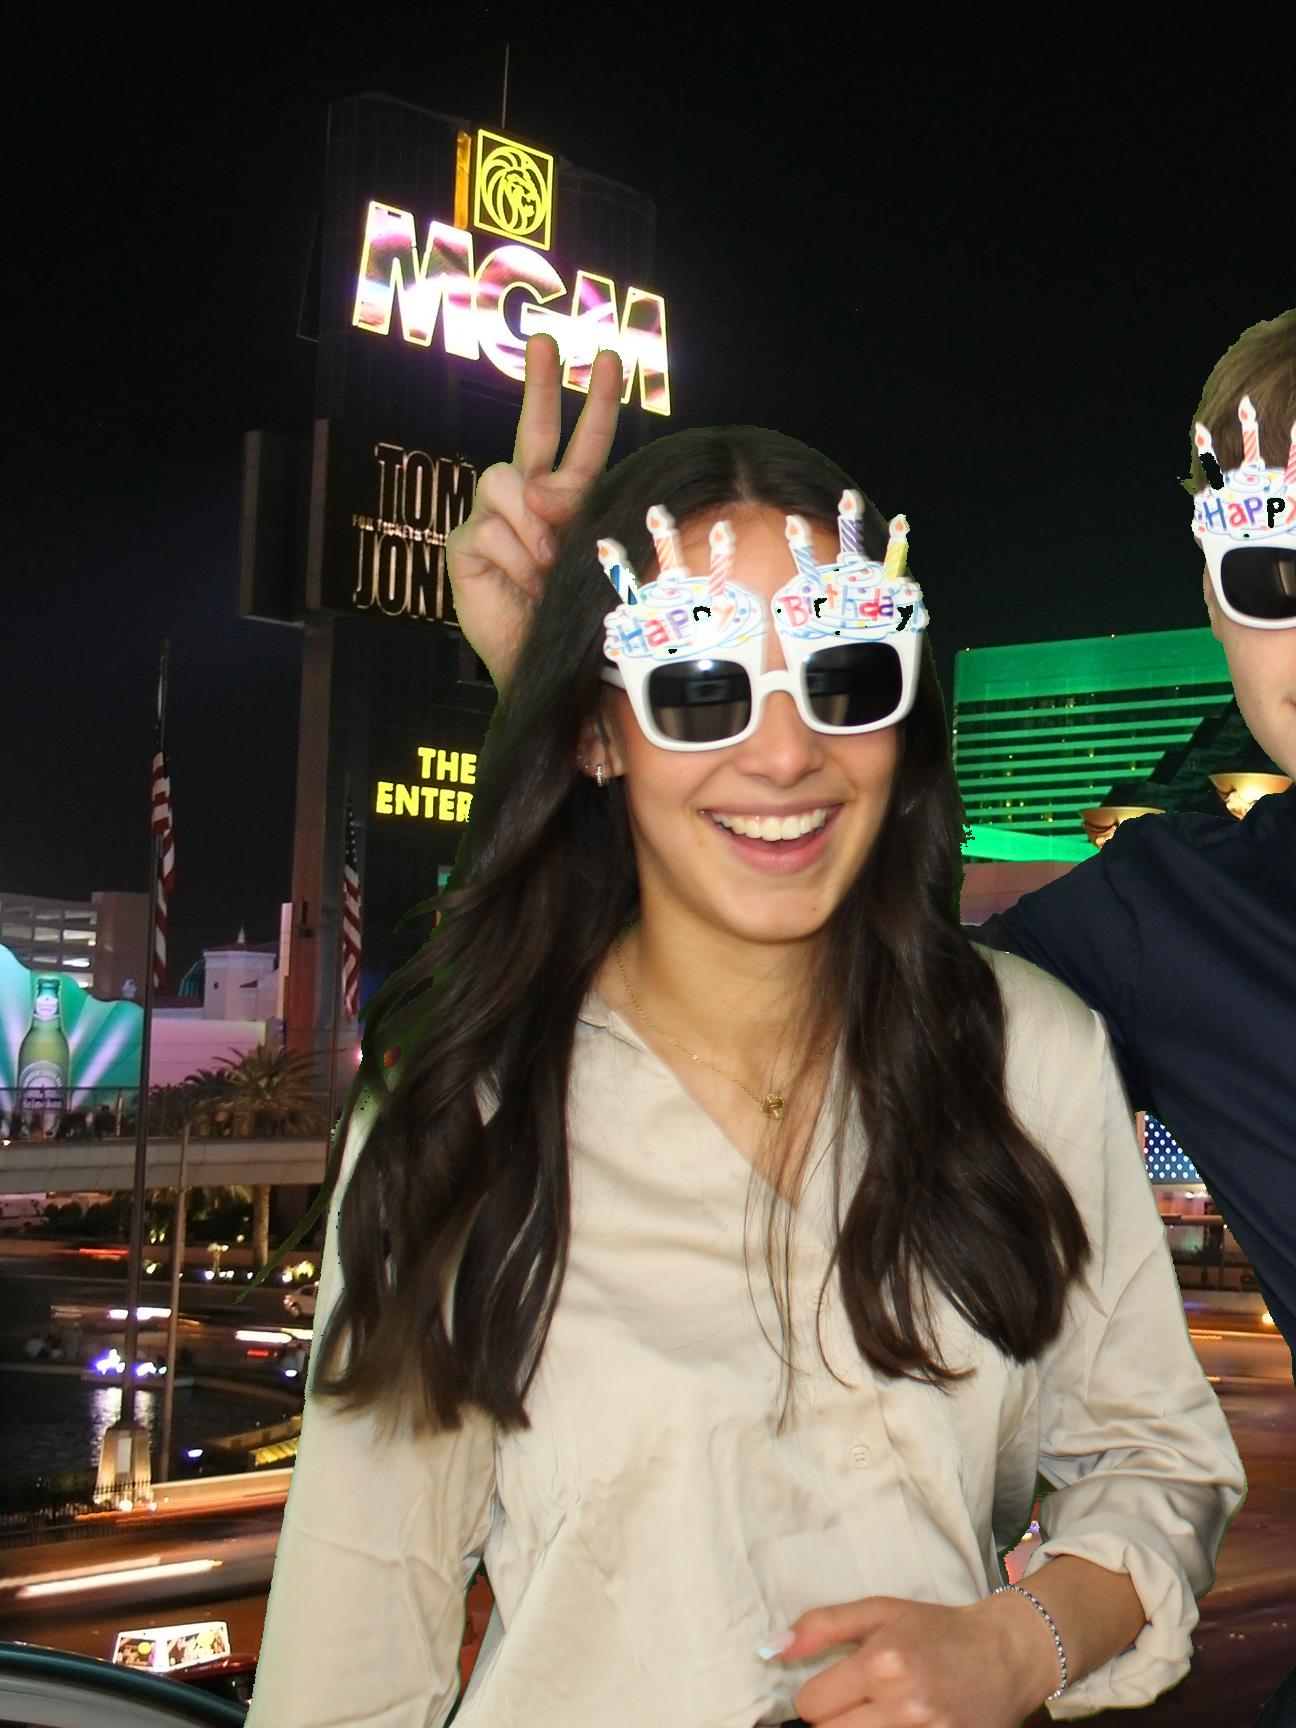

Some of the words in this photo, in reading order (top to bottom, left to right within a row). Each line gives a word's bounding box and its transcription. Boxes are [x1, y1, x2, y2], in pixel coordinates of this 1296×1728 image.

[353, 201, 670, 416] MGM
[374, 442, 477, 535] TOM
[418, 747, 477, 785] THE
